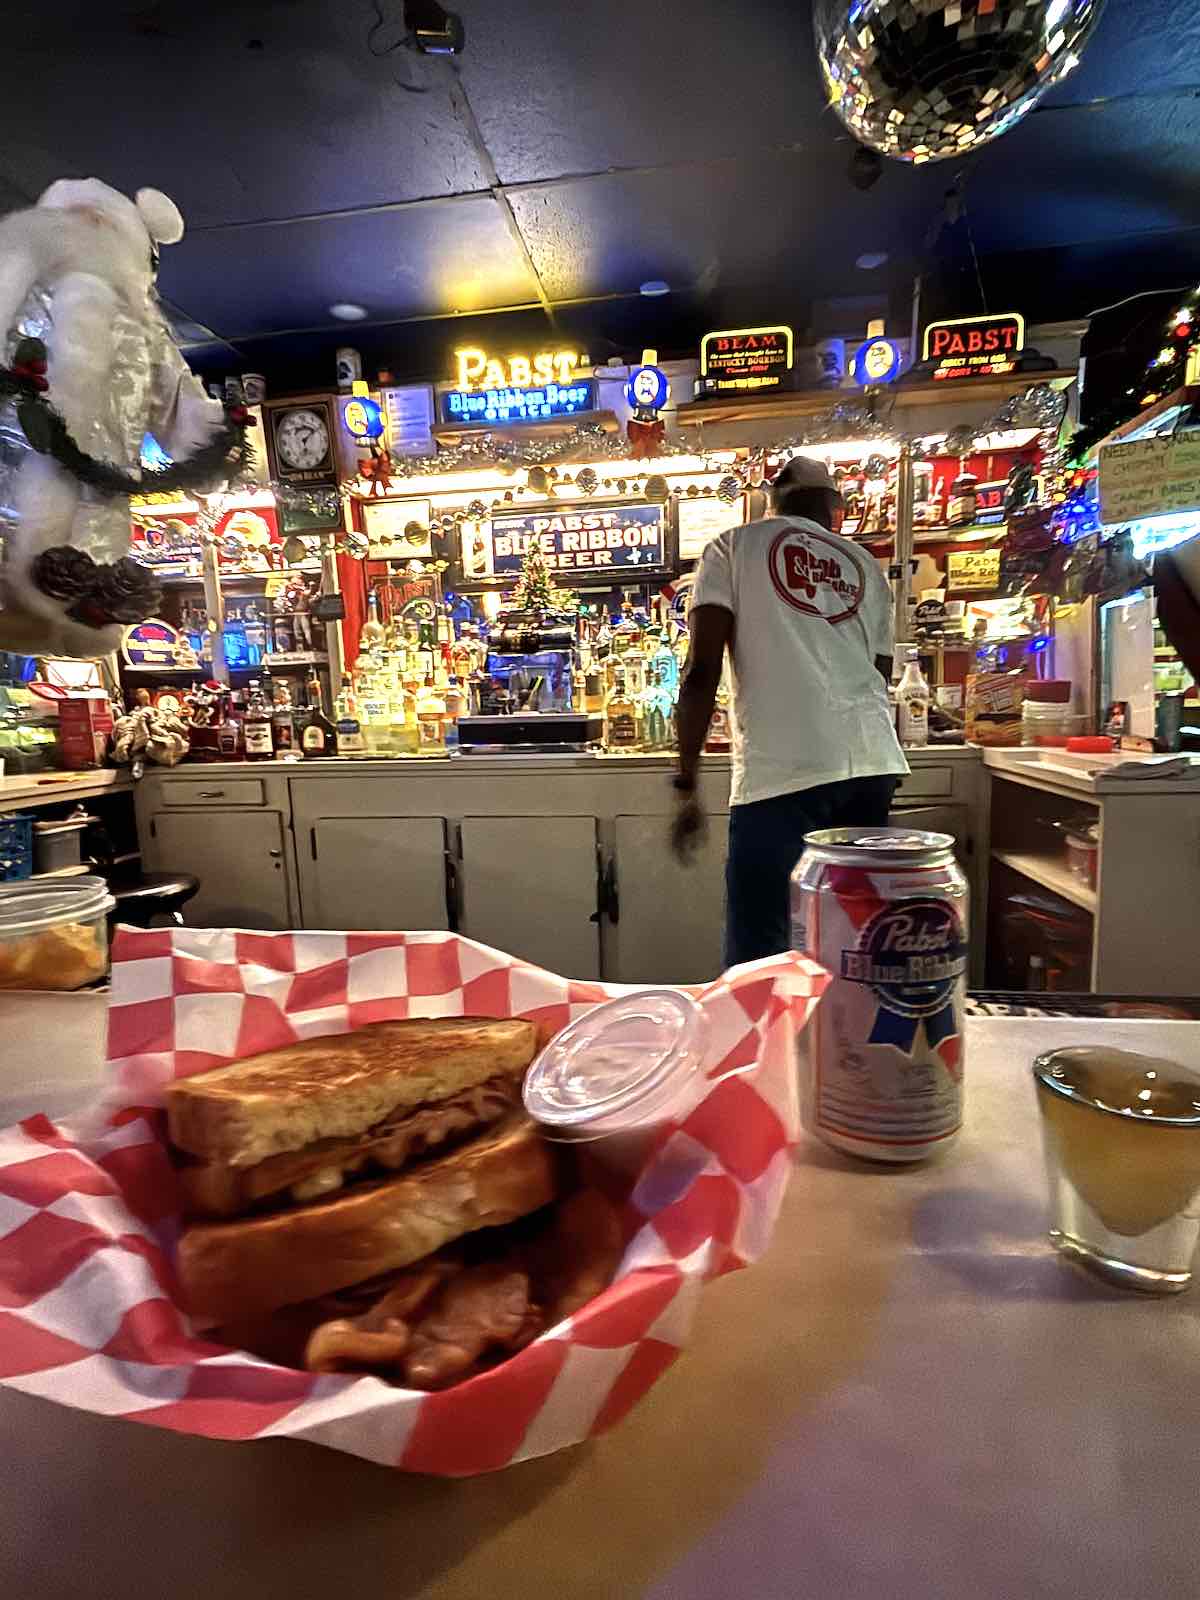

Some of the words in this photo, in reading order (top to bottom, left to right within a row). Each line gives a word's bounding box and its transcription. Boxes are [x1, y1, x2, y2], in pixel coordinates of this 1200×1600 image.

[933, 326, 1017, 357] PABST
[454, 347, 578, 393] PABST
[449, 392, 487, 413] Blue
[486, 387, 545, 409] Ribbon
[545, 383, 589, 405] Beer
[533, 512, 617, 532] PABST
[562, 525, 658, 551] RIBBON
[543, 550, 613, 568] BEER
